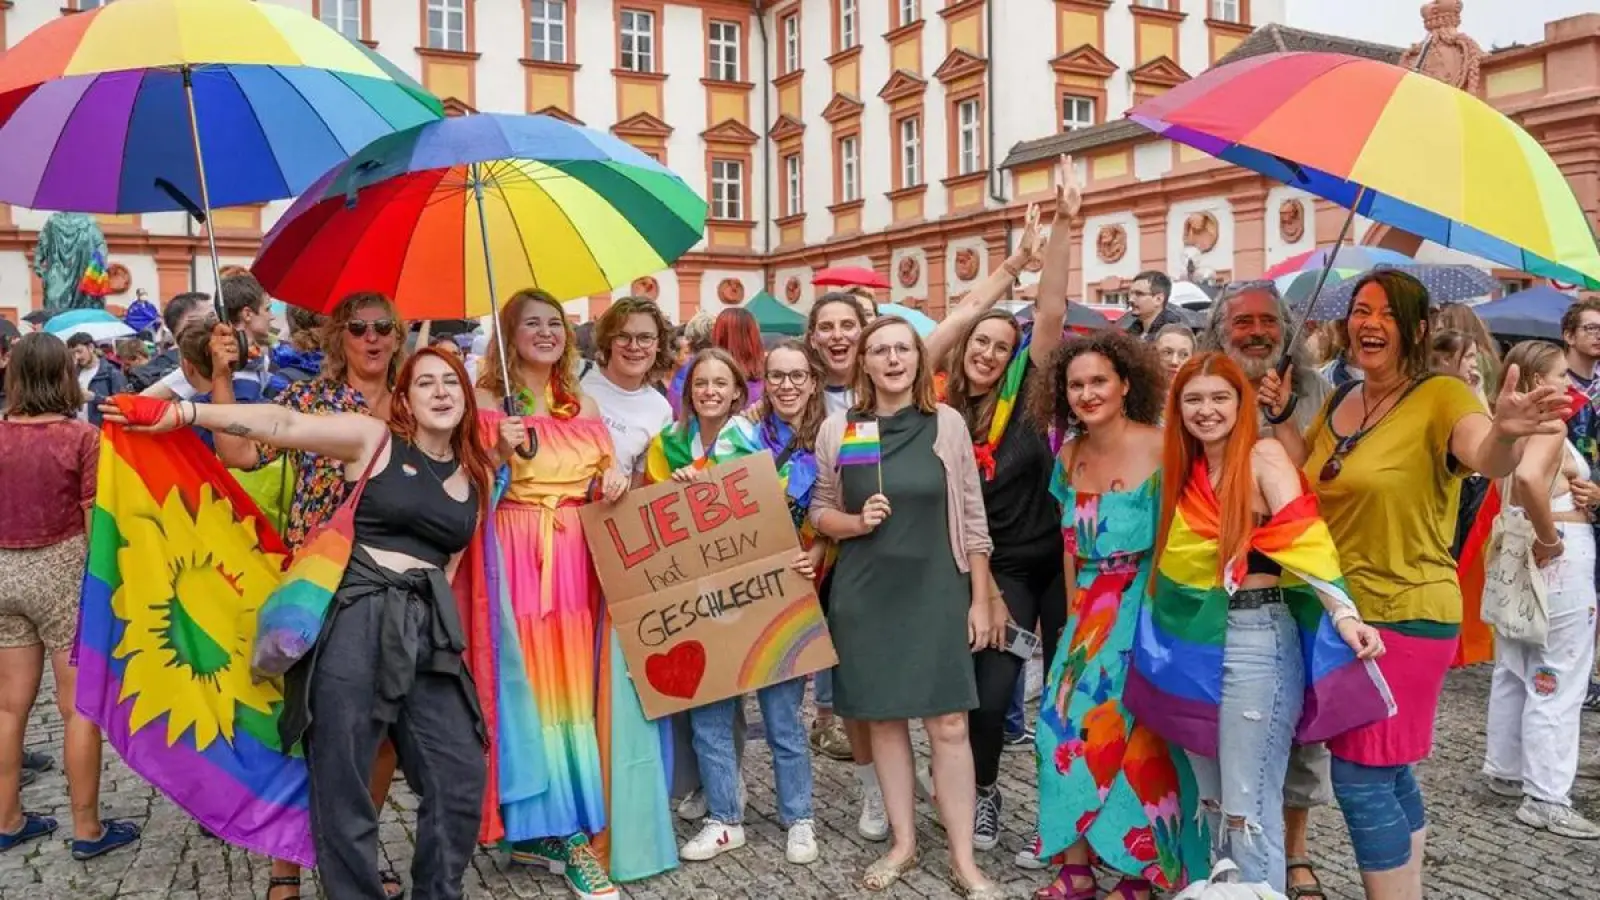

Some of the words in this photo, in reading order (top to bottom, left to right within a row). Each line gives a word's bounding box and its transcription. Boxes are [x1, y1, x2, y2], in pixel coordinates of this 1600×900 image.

[604, 467, 760, 569] LIEBE
[644, 555, 689, 592] hat
[700, 530, 759, 568] KEIN
[638, 568, 785, 647] GESCHLECHT
